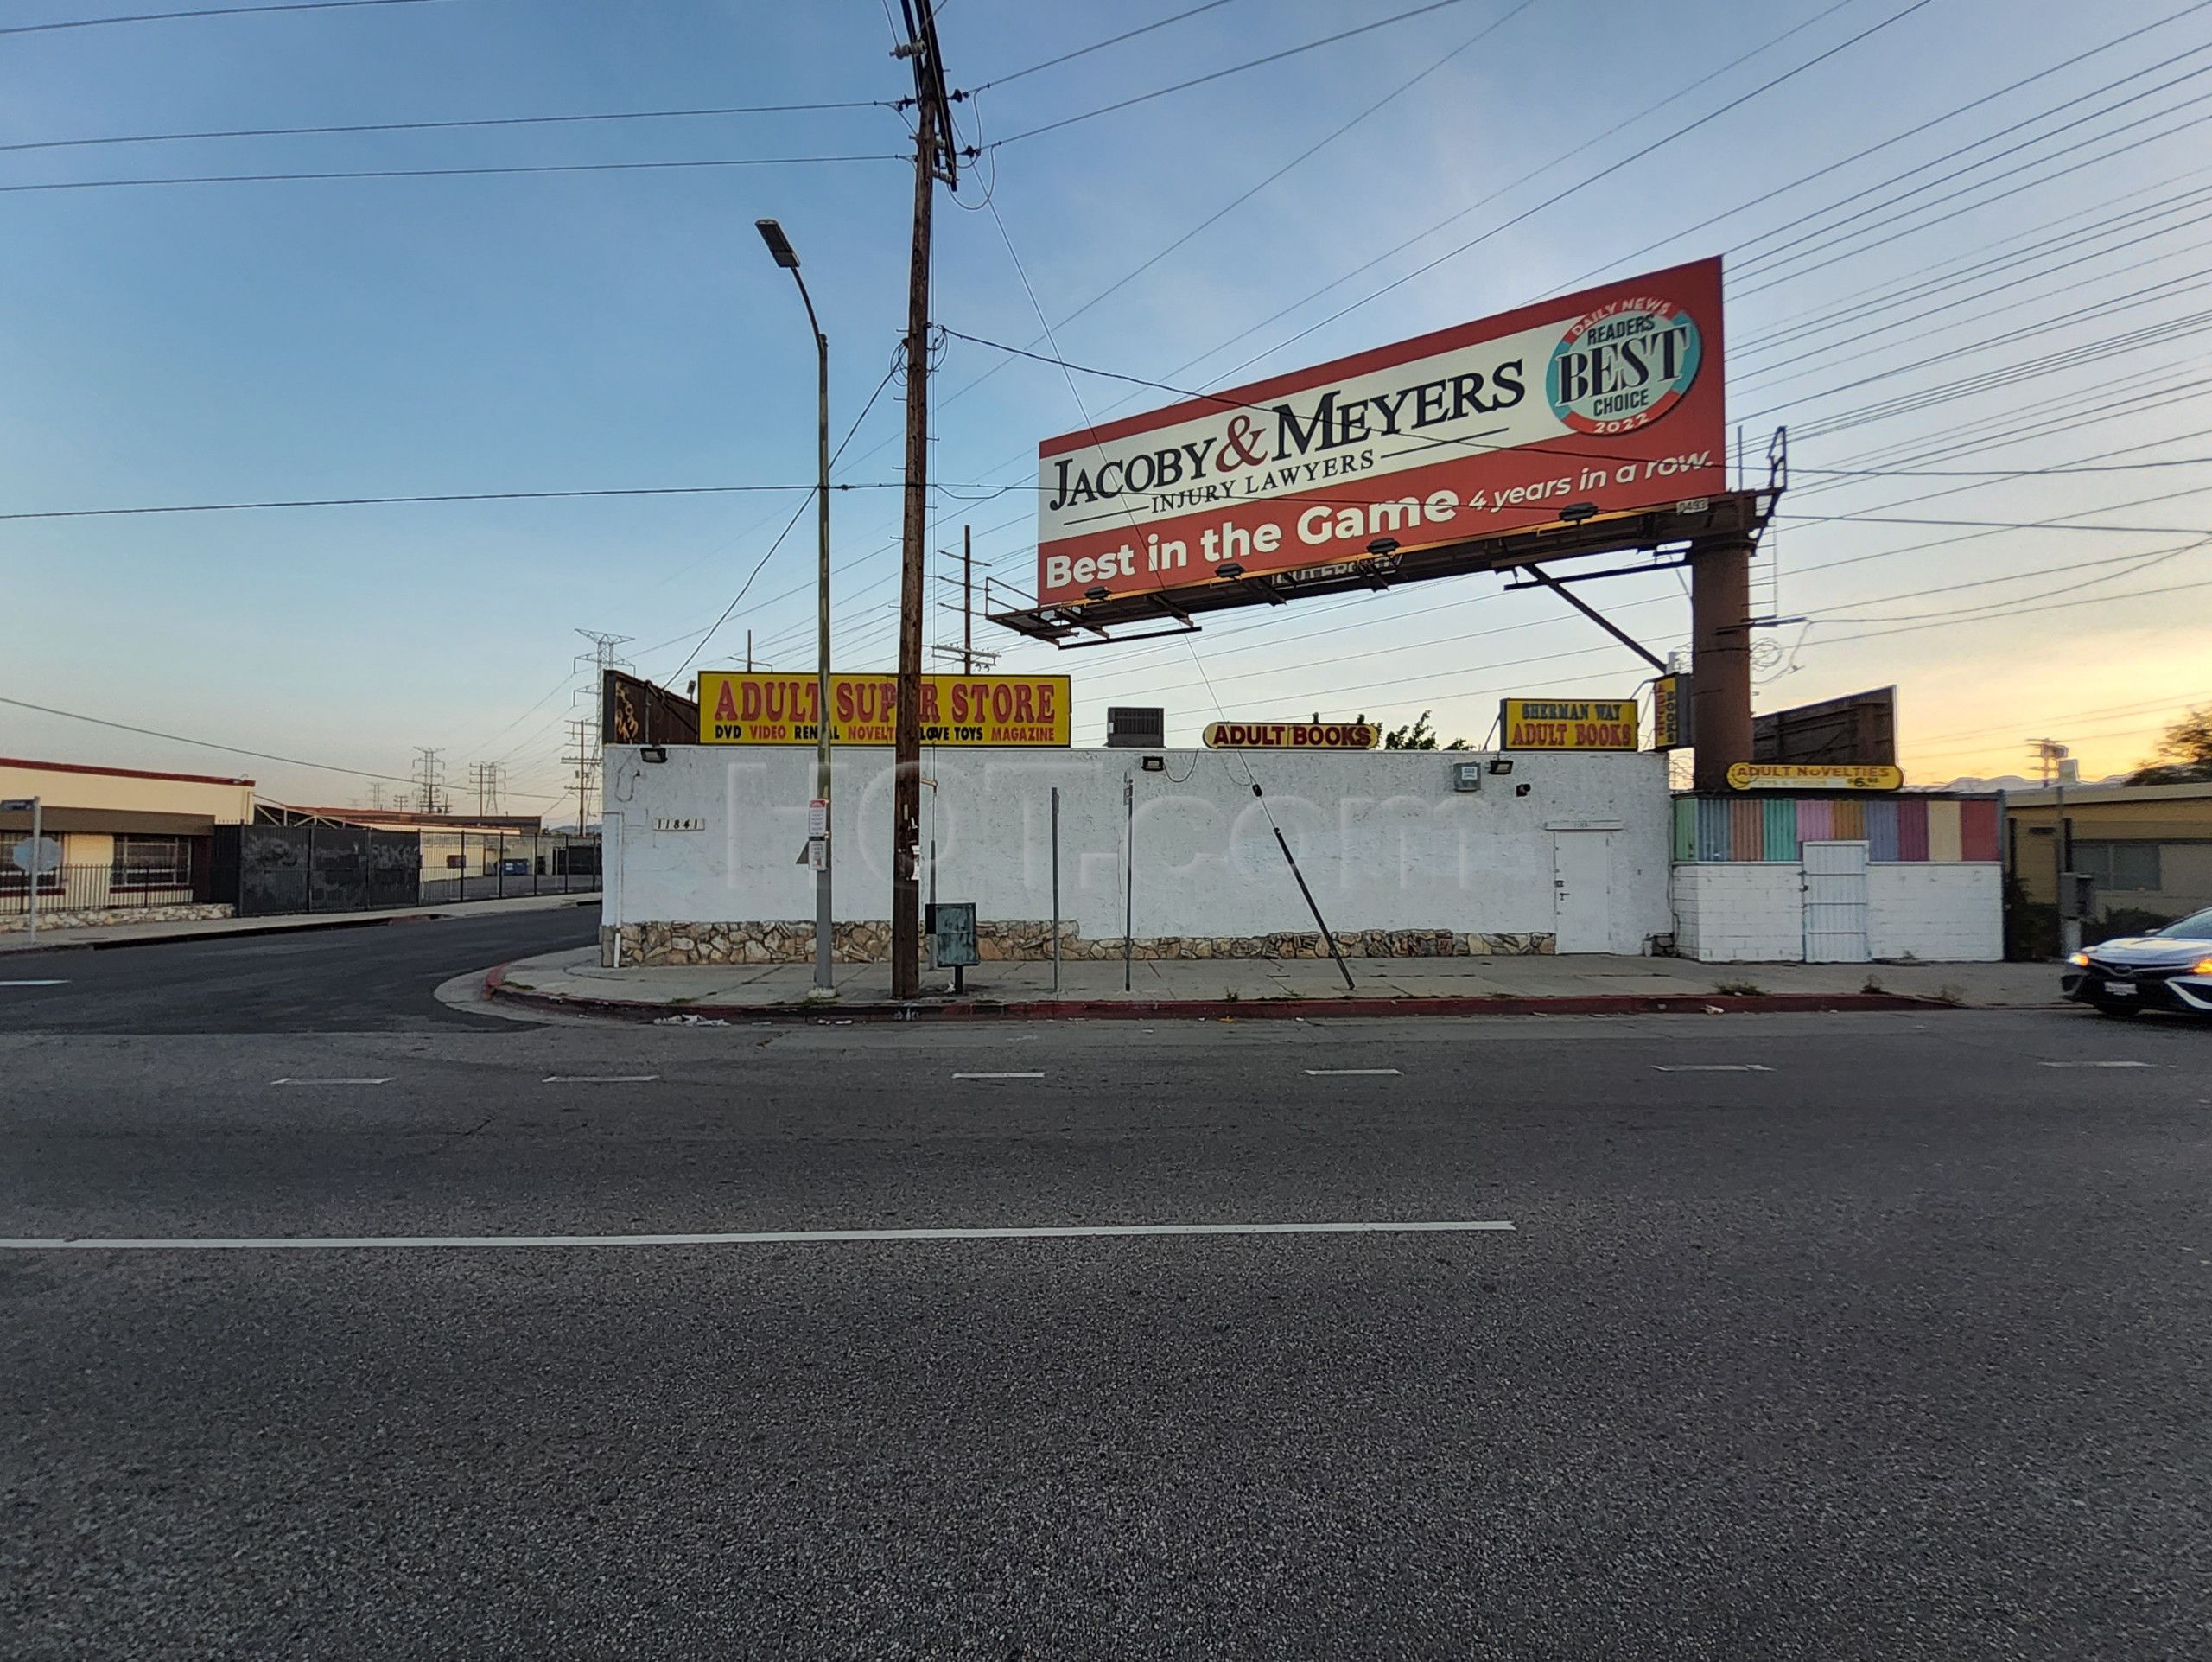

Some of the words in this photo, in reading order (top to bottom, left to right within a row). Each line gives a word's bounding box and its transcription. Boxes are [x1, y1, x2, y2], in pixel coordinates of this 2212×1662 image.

[1572, 302, 1617, 336] DAILY
[1621, 297, 1672, 315] NEWS
[1587, 313, 1655, 346] READERS
[1557, 325, 1688, 405] BEST
[1593, 389, 1649, 417] CHOICE
[1049, 437, 1217, 511] JACOBY
[1215, 415, 1268, 473] &
[1271, 358, 1525, 462] MEYERS
[1594, 413, 1649, 434] 2022
[1151, 480, 1236, 513] INJURY
[1245, 449, 1374, 494] LAWYERS
[1469, 489, 1486, 510] 4
[1493, 476, 1572, 513] years
[1579, 468, 1606, 491] in
[1616, 463, 1637, 484] a
[1645, 450, 1713, 480] row.
[1046, 544, 1135, 589] Best
[1148, 533, 1187, 572] in
[1200, 522, 1282, 562] the
[1297, 489, 1459, 545] Game
[836, 682, 940, 724] SUPR
[952, 683, 1055, 724] STORE
[1522, 703, 1589, 720] SHERMAN
[1594, 704, 1623, 721] WAY
[715, 725, 741, 740] DVD
[749, 725, 785, 740] VIDEO
[795, 725, 840, 740] RENL
[919, 726, 950, 741] LOVE
[954, 726, 982, 741] TOYS
[991, 727, 1054, 742] MAGAZINE
[1213, 725, 1286, 745] ADULT
[1294, 726, 1372, 746] BOOKS
[1512, 723, 1567, 746] ADULT
[1574, 724, 1632, 746] BOOKS
[1737, 767, 1791, 776] ADULT
[1796, 767, 1890, 777] NOVELTIES
[658, 818, 698, 830] 11841
